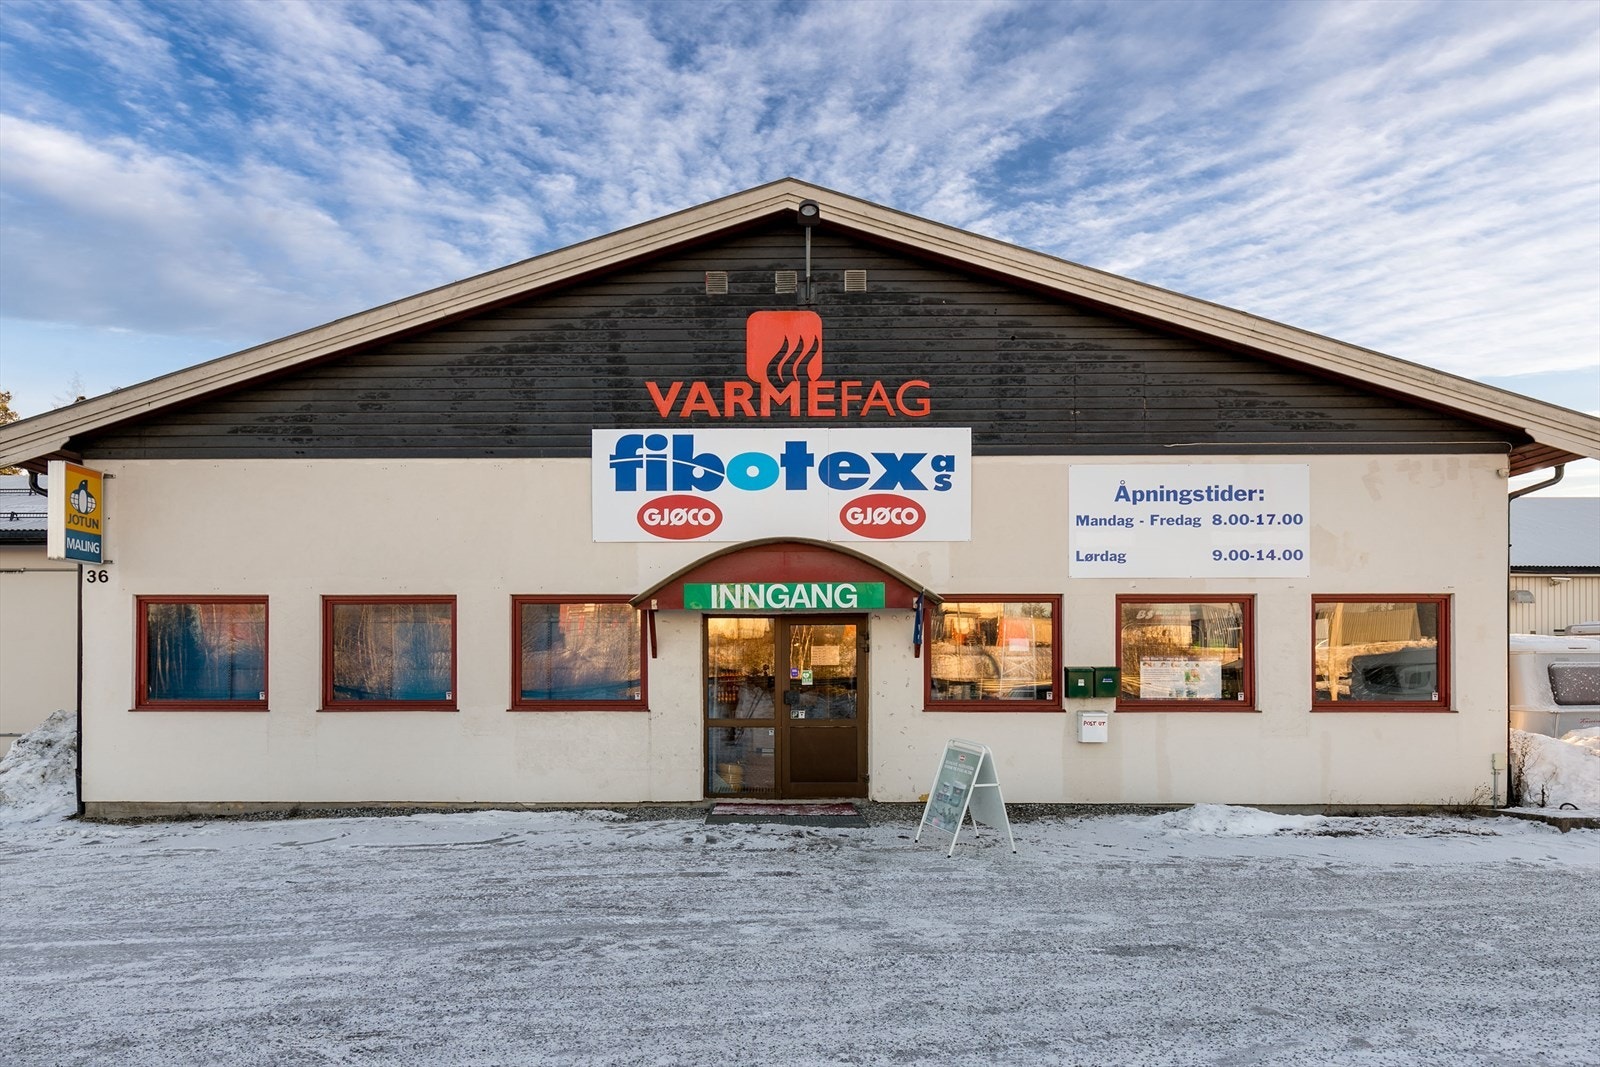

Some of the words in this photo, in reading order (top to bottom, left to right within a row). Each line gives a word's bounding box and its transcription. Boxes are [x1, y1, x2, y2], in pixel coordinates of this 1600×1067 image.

[645, 380, 931, 418] VARMEFAG
[609, 433, 928, 492] fibotex
[1114, 479, 1264, 505] Åpningstider:
[67, 513, 100, 530] JOTUN
[643, 507, 716, 526] GJØCO
[846, 506, 919, 526] GJØCO
[1075, 514, 1134, 528] Mandag
[1150, 514, 1202, 528] Fredag
[1212, 513, 1304, 526] 8.00-17.00
[66, 537, 100, 554] MALING
[1075, 550, 1127, 564] Lørdag
[1212, 549, 1304, 561] 9.00-14.00
[86, 569, 109, 584] 36
[711, 583, 858, 609] INNGANG
